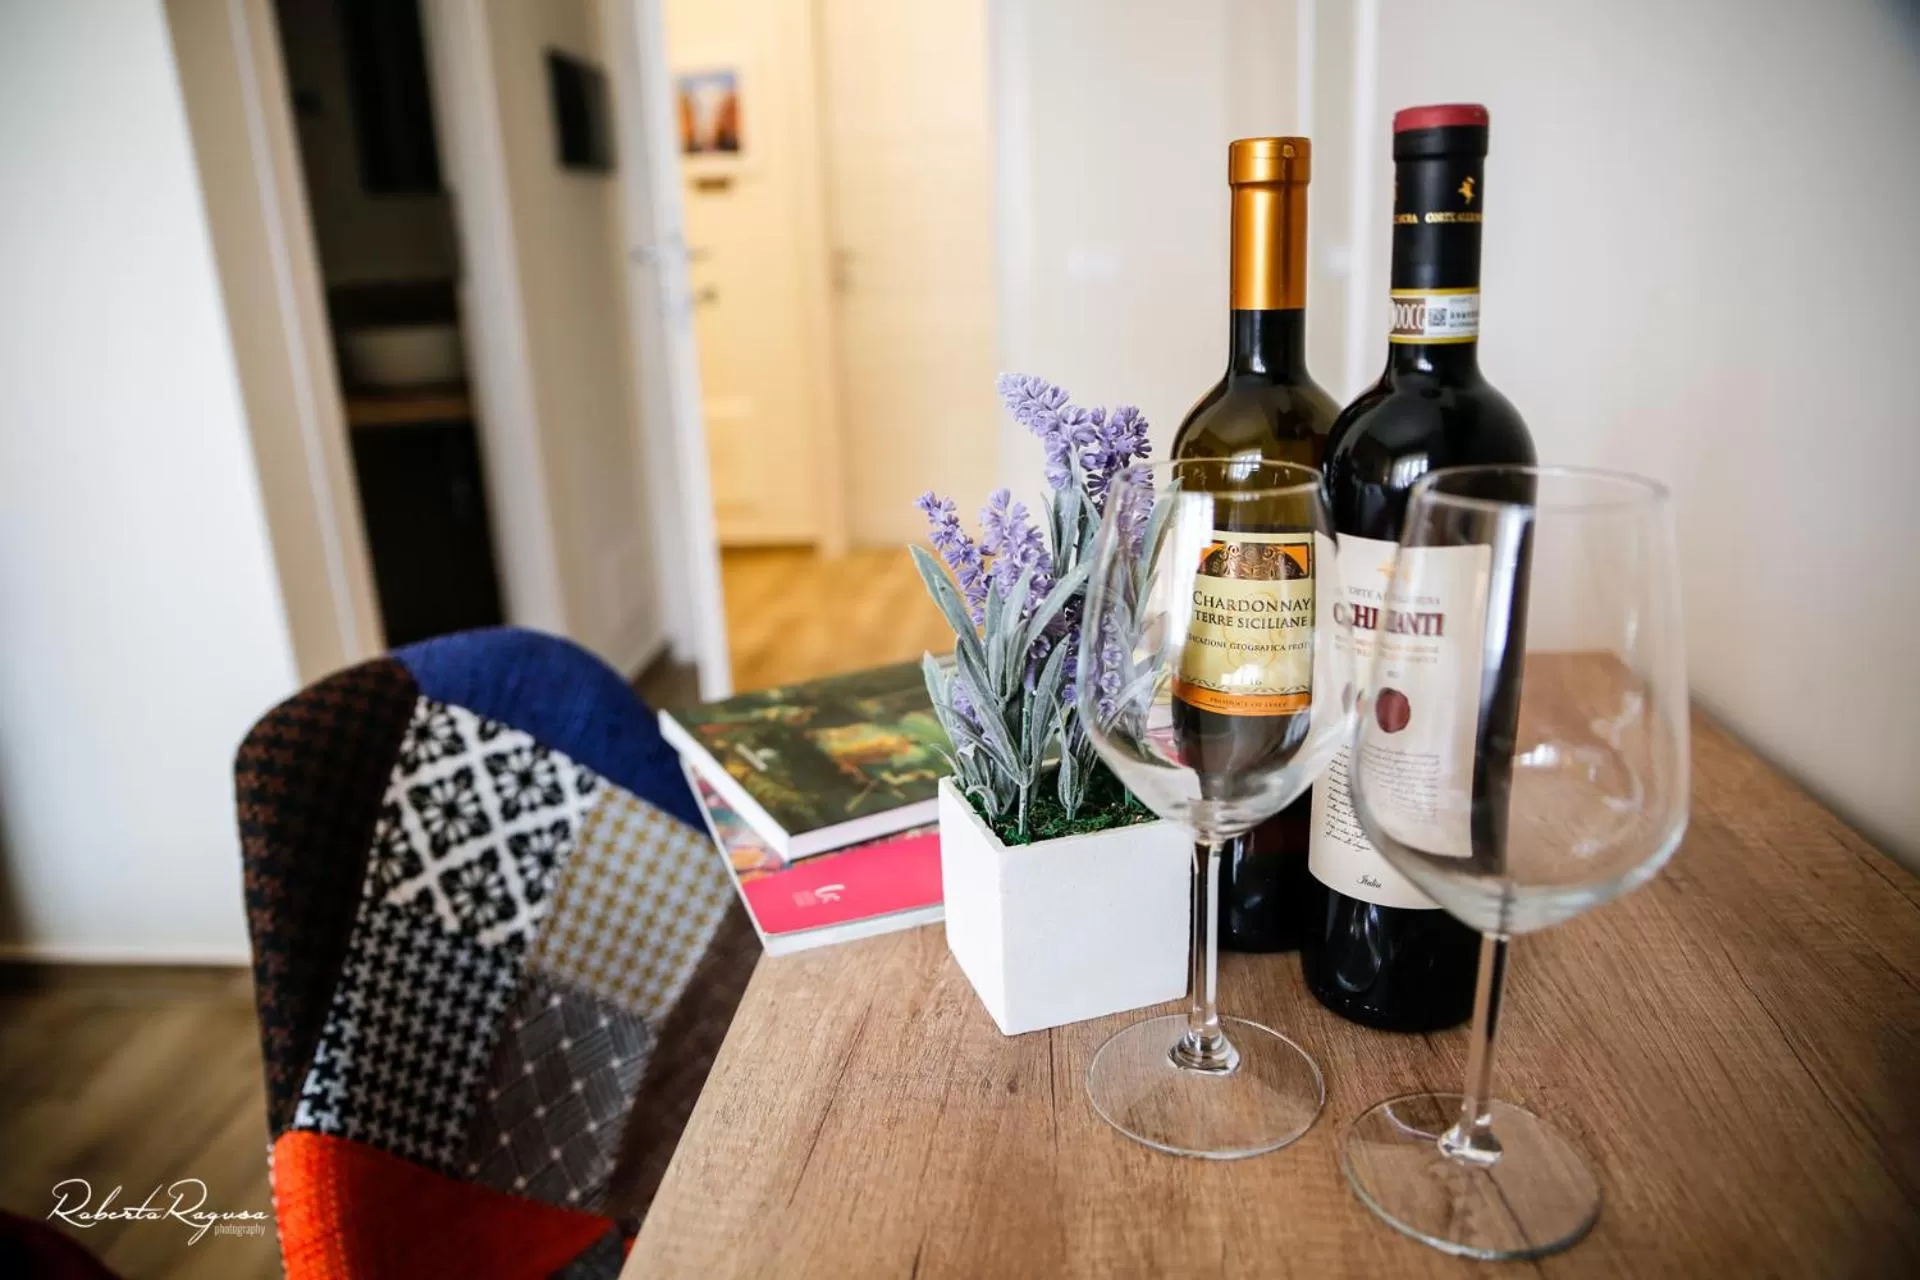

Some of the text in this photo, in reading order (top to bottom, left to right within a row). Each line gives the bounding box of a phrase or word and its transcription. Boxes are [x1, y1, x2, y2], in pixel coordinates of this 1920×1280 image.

[1193, 590, 1311, 612] CHARDONNAY
[1195, 610, 1308, 629] TERRE SICILIANE
